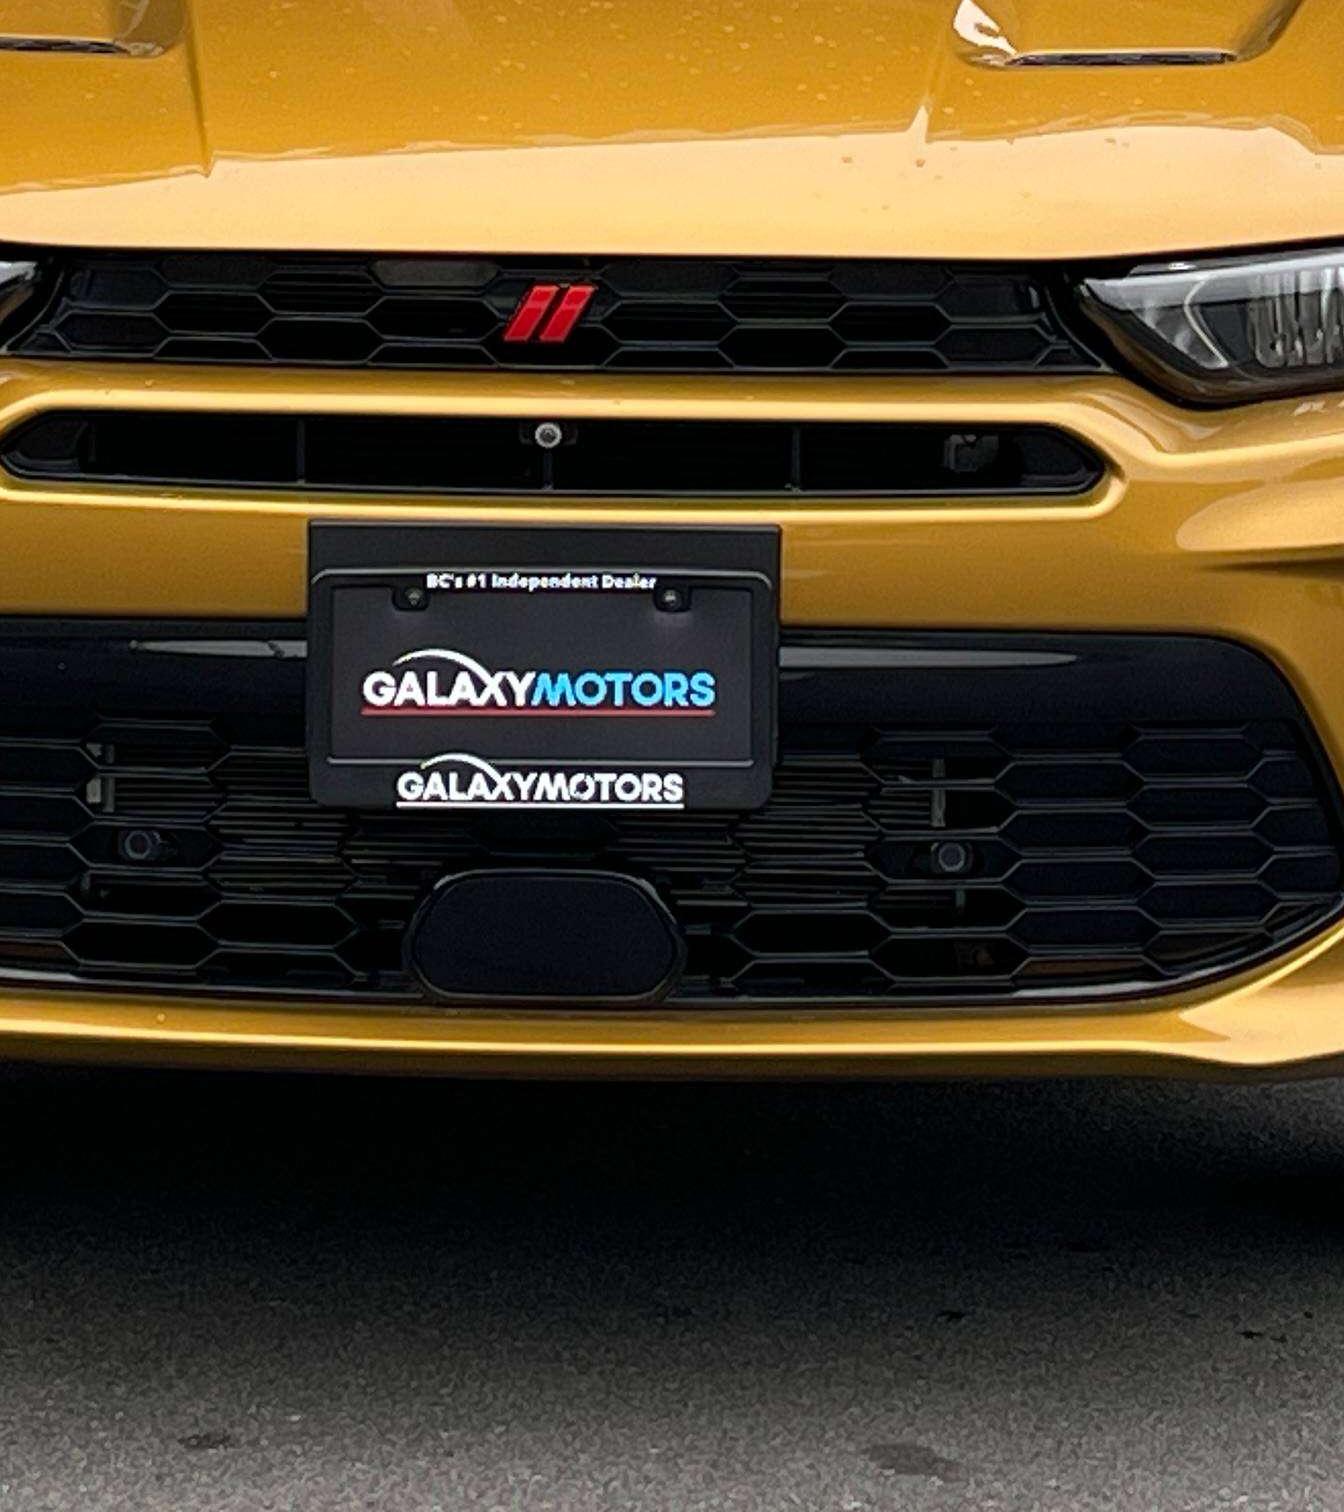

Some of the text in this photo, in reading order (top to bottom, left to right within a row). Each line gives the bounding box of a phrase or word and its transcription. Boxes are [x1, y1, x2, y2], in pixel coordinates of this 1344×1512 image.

[426, 572, 657, 593] BC's #1 Independent Dealer
[362, 669, 717, 708] GALAXYMOTORS
[396, 771, 685, 802] GALAXYMOTORS
